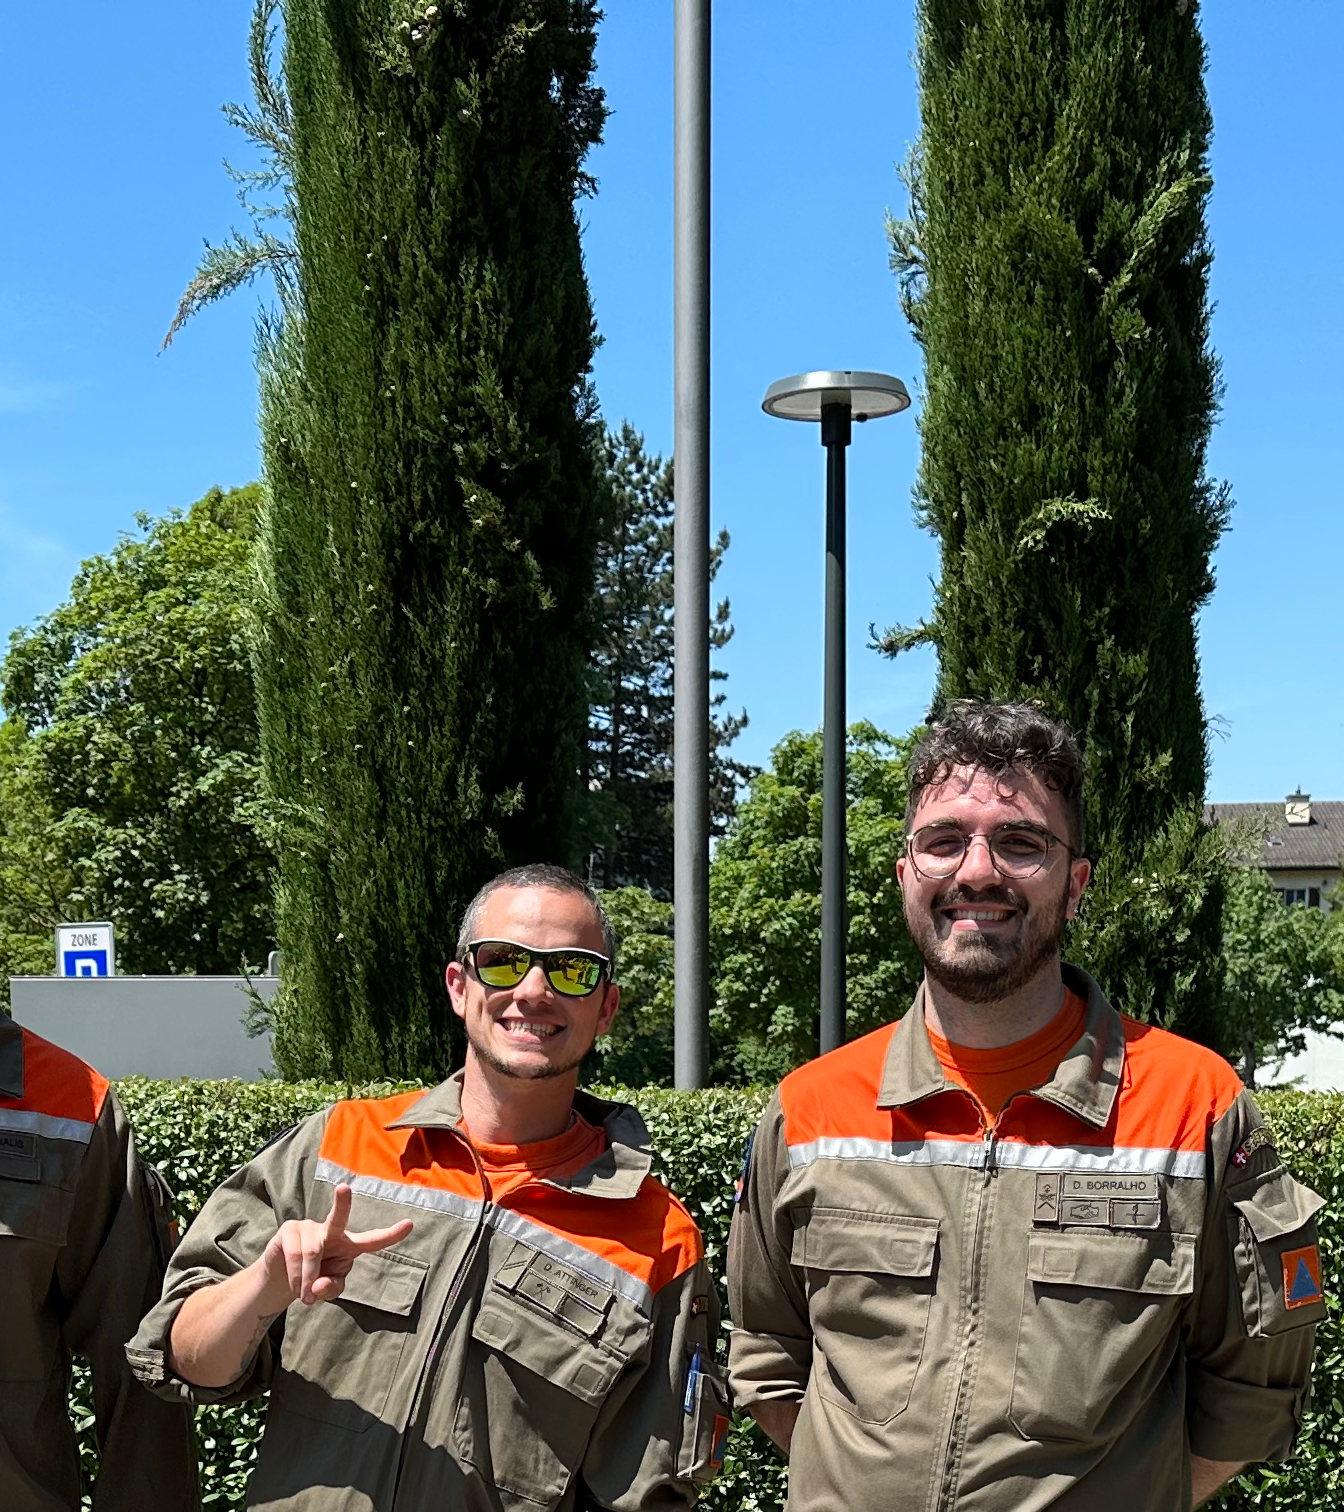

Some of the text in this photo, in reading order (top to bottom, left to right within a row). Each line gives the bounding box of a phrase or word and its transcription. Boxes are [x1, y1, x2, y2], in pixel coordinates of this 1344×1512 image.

[71, 933, 98, 947] ZONE
[1073, 1181, 1147, 1191] D. BORRALHO
[544, 1263, 599, 1299] D. ATTINGER
